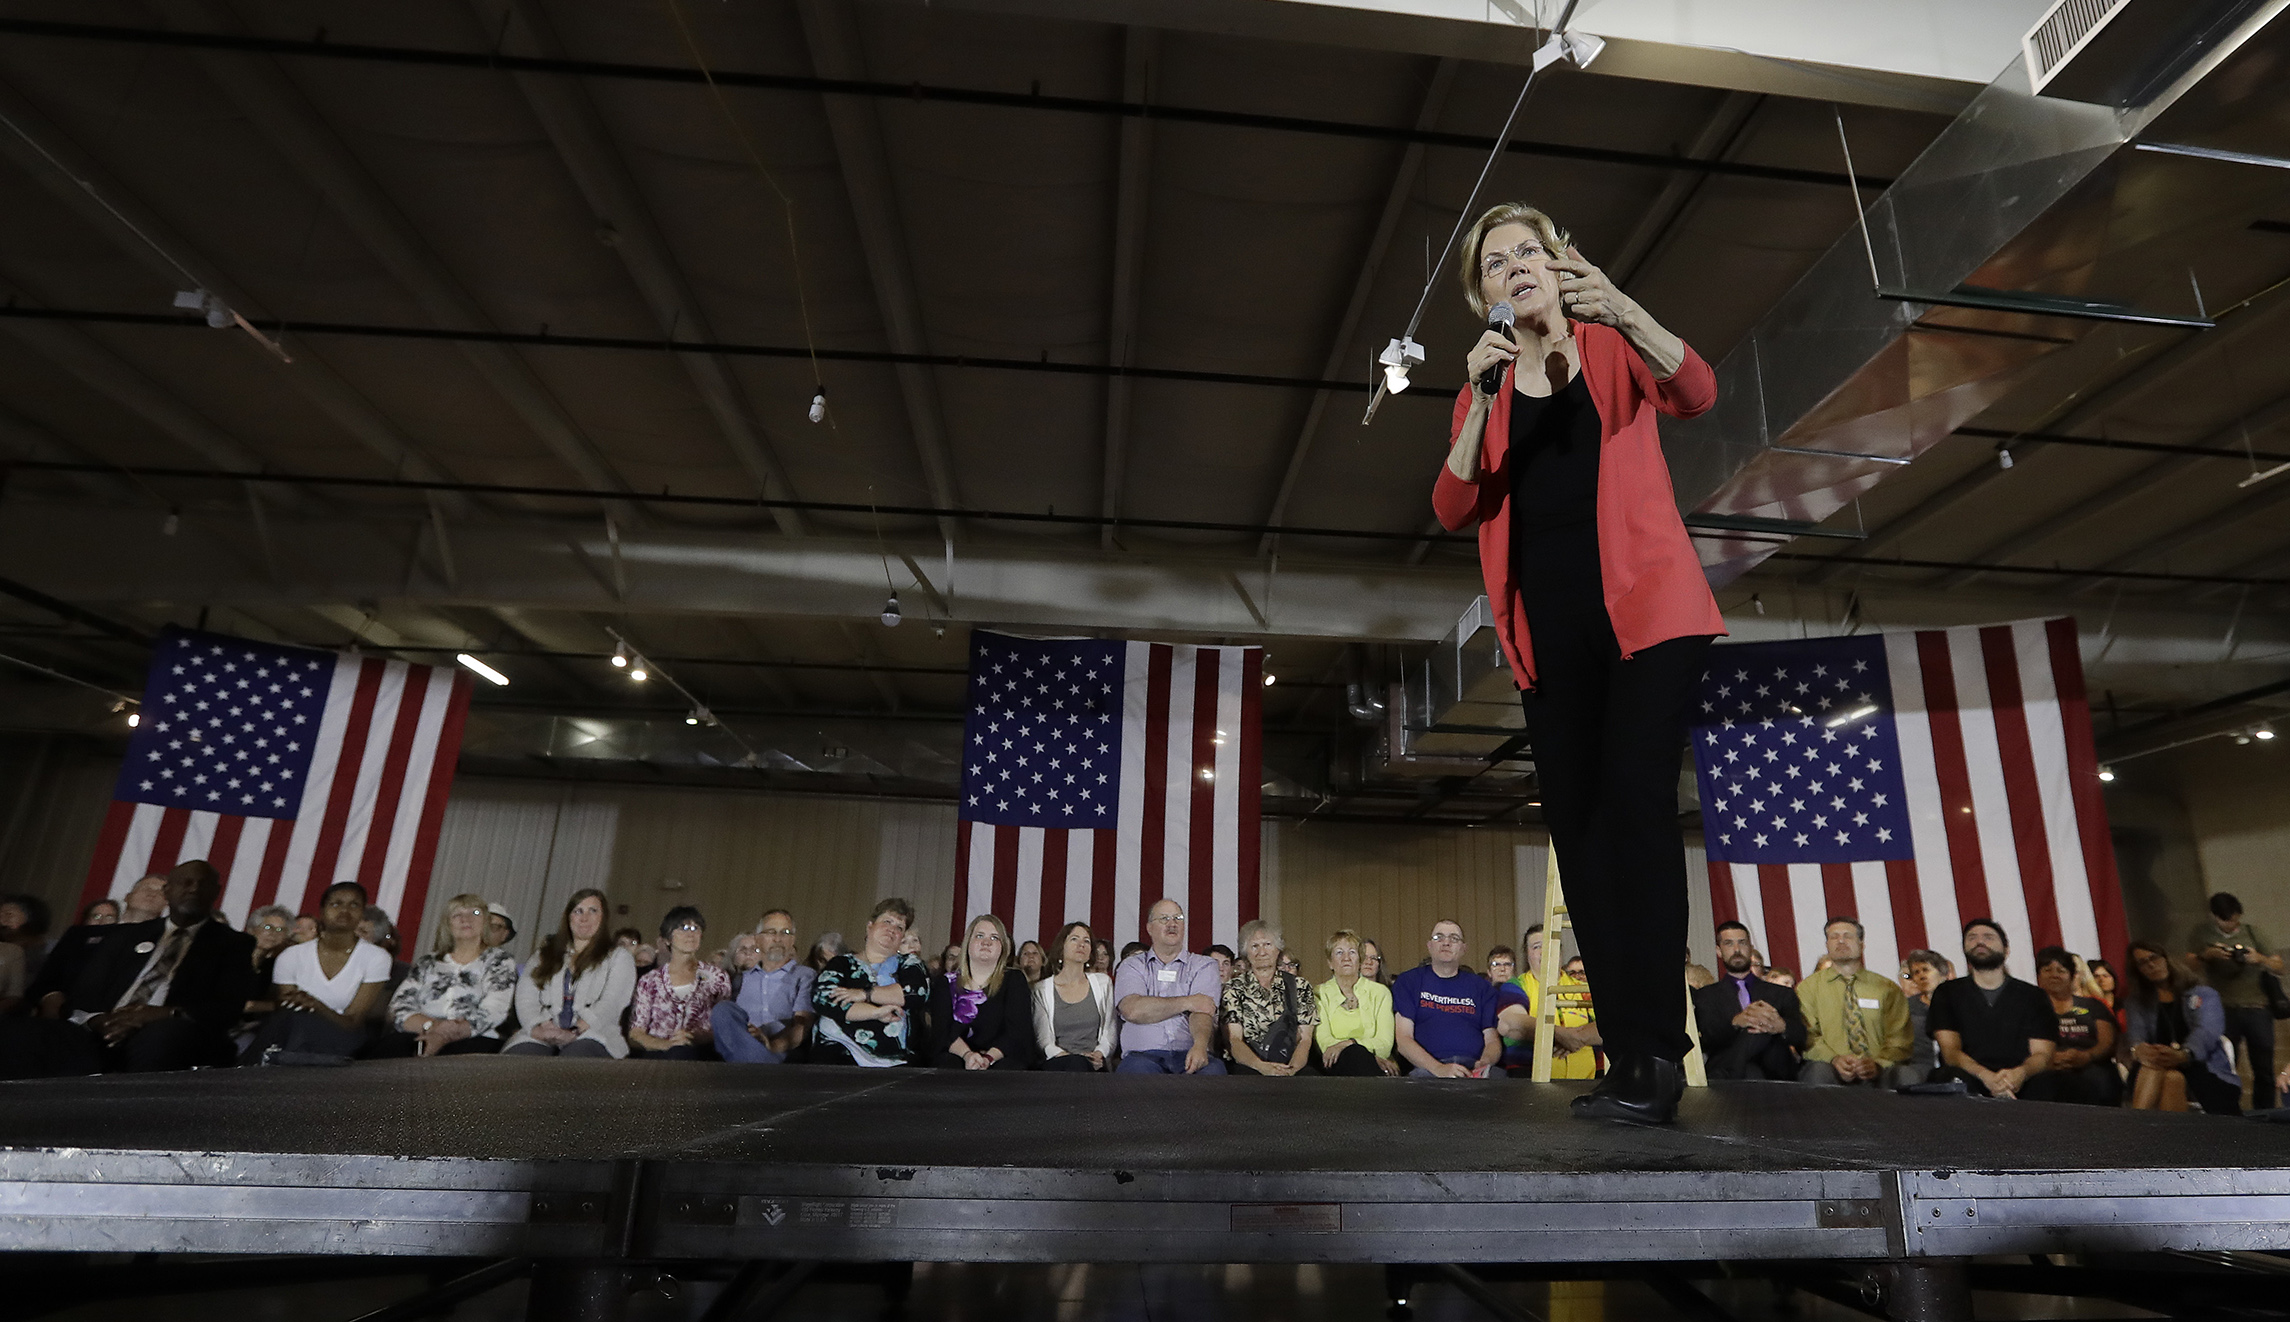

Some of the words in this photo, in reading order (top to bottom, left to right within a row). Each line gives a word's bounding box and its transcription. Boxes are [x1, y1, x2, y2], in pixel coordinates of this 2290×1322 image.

[1420, 991, 1476, 1007] NEVERTHELESS,
[1420, 999, 1435, 1008] SHE
[1436, 1003, 1476, 1015] PERSISTED
